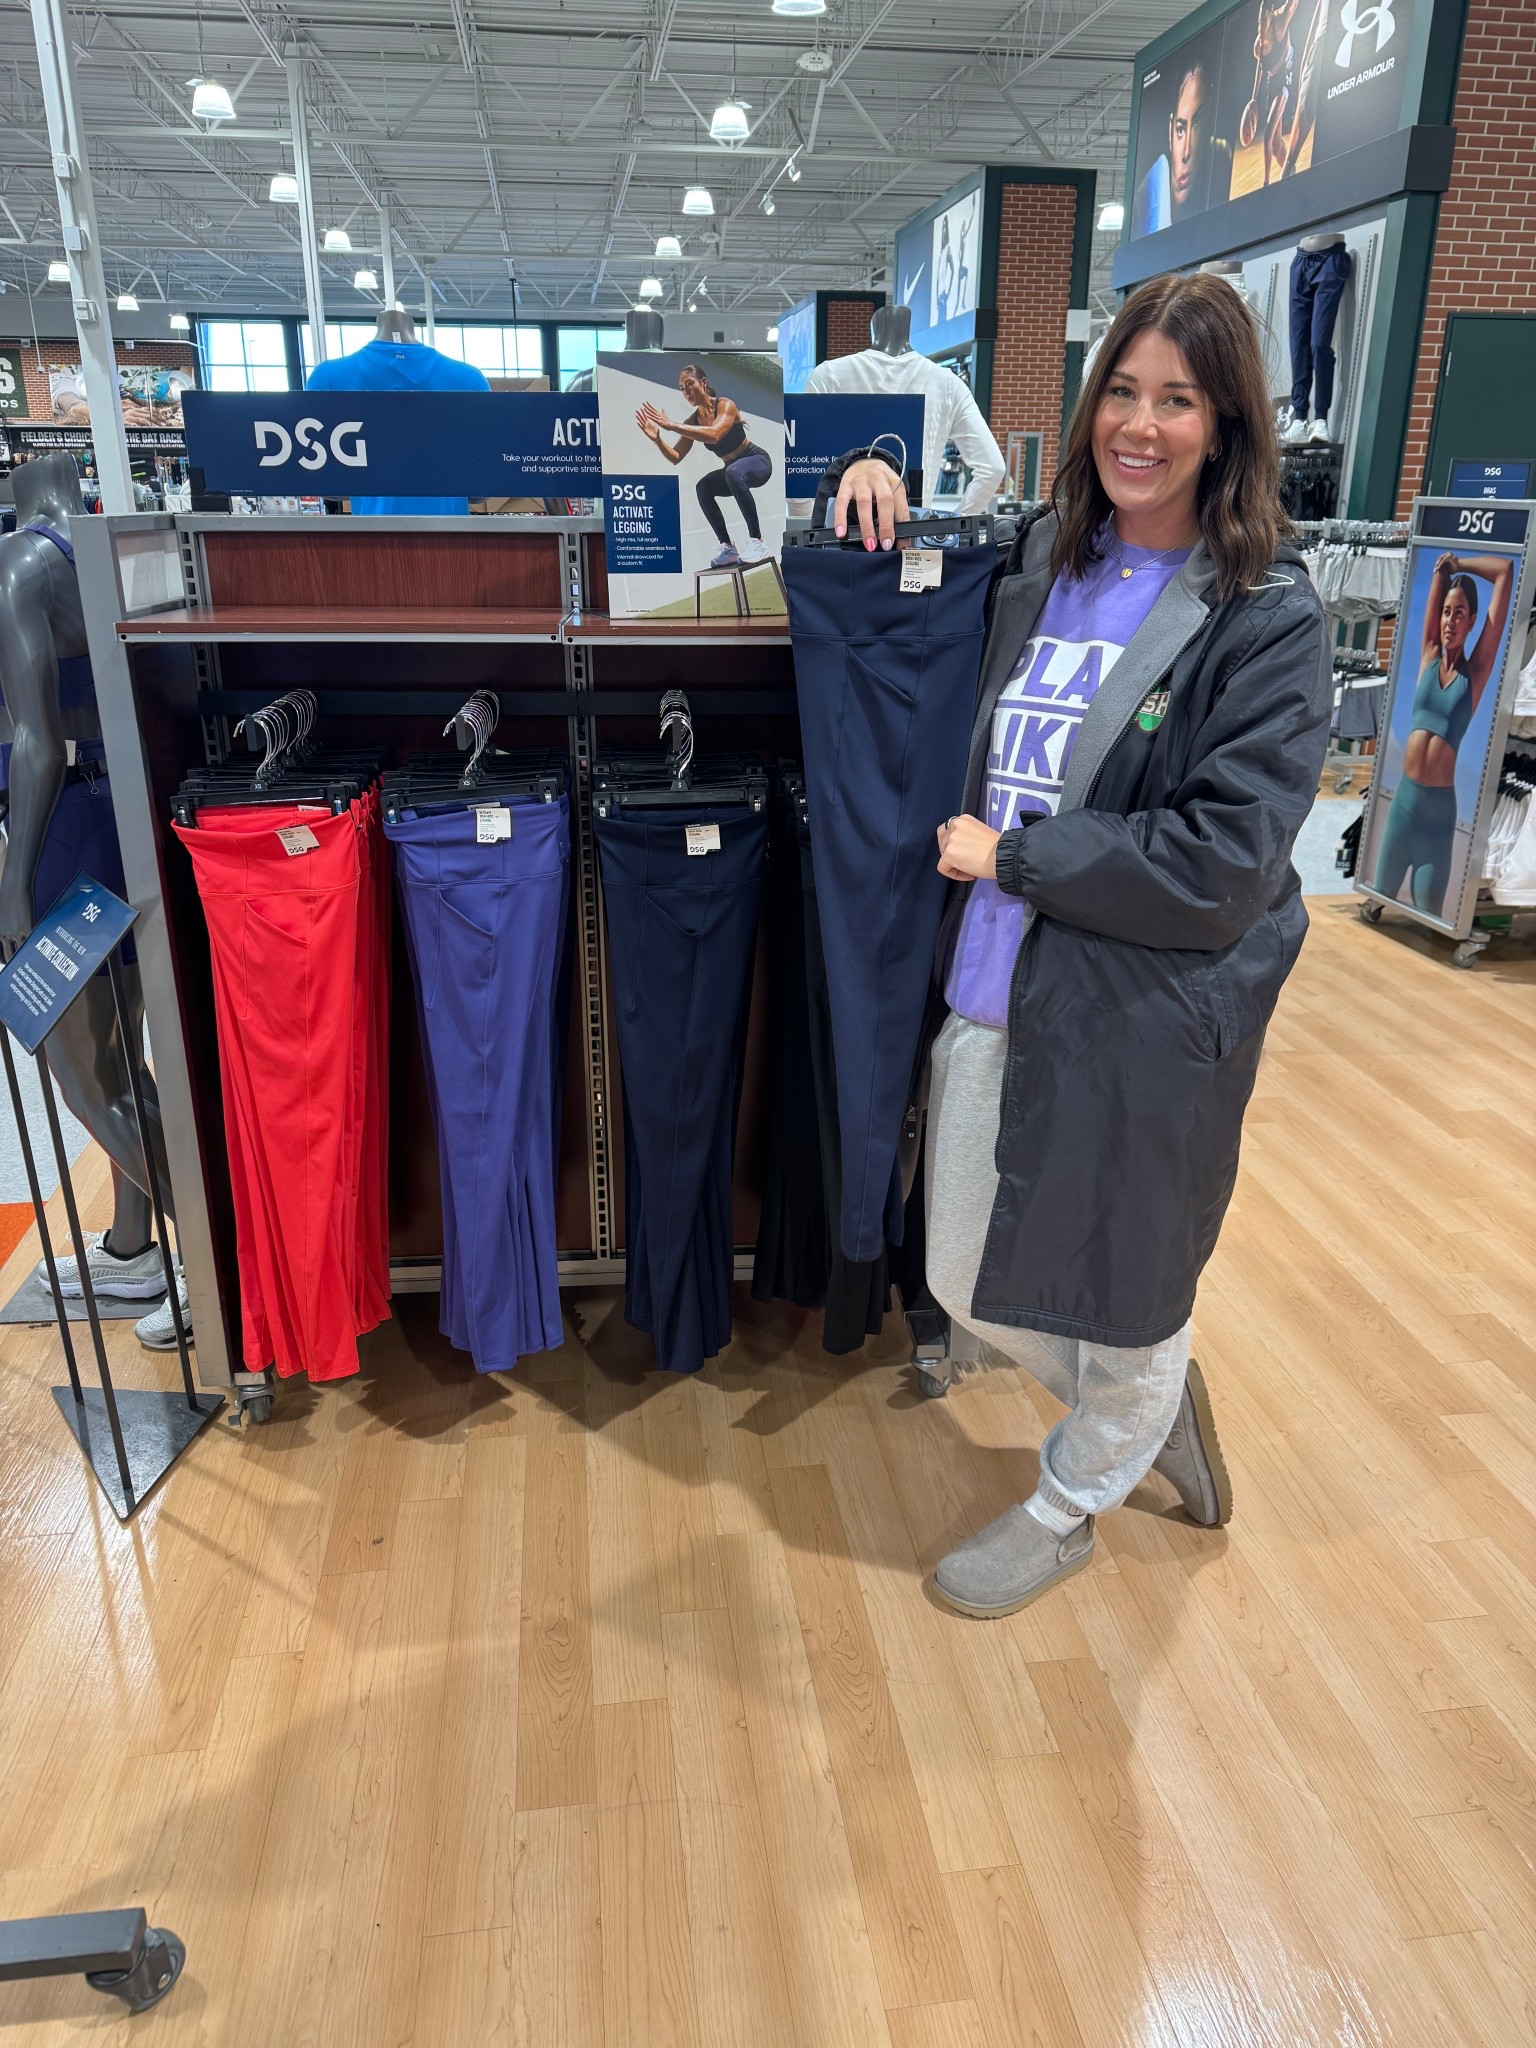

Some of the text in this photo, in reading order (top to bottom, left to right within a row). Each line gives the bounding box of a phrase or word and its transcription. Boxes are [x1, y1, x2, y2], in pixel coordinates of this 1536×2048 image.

[1327, 56, 1395, 100] UNDER ARMOUR
[20, 431, 63, 443] FIELDER'S
[141, 433, 158, 444] BAT
[159, 433, 184, 444] RACK
[253, 417, 368, 471] DSG
[502, 453, 598, 463] Take your workout to the
[791, 455, 810, 464] cool,
[810, 455, 830, 463] sleek
[521, 464, 537, 473] and
[538, 464, 579, 474] supportive
[787, 466, 826, 475] protection
[1484, 467, 1502, 476] DSG
[611, 484, 646, 501] DSG
[612, 505, 654, 519] ACTIVATE
[1457, 509, 1496, 534] DSG
[613, 521, 652, 534] LEGGING
[903, 580, 921, 589] DSG
[479, 833, 495, 841] DSG
[81, 902, 102, 923] DSG
